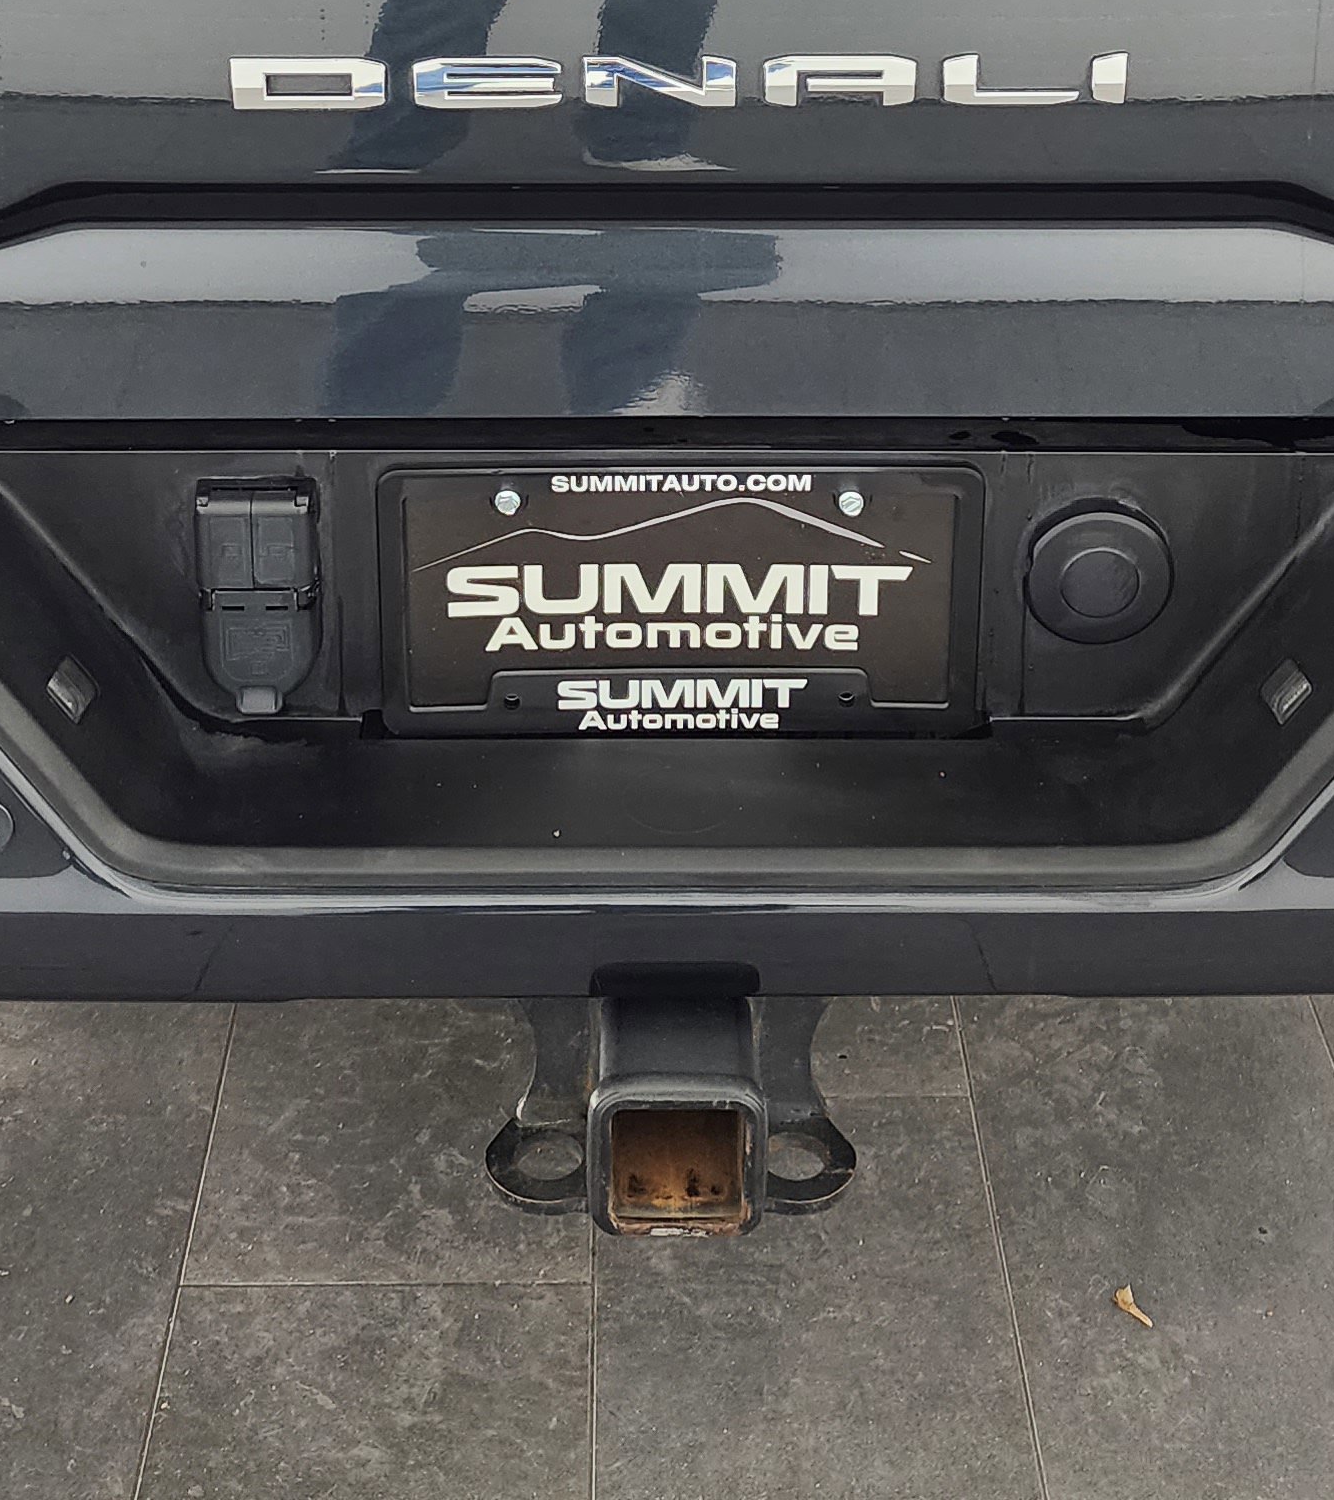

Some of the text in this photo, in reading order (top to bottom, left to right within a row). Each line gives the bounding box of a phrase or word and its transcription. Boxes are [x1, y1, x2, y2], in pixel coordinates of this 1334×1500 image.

[229, 51, 1128, 110] DENALI
[550, 474, 813, 493] SUMMITAUTO.COM
[446, 563, 914, 617] SUMMIT
[485, 615, 859, 652] Automotive
[557, 678, 808, 710] SUMMIT
[578, 709, 780, 731] Automotive
